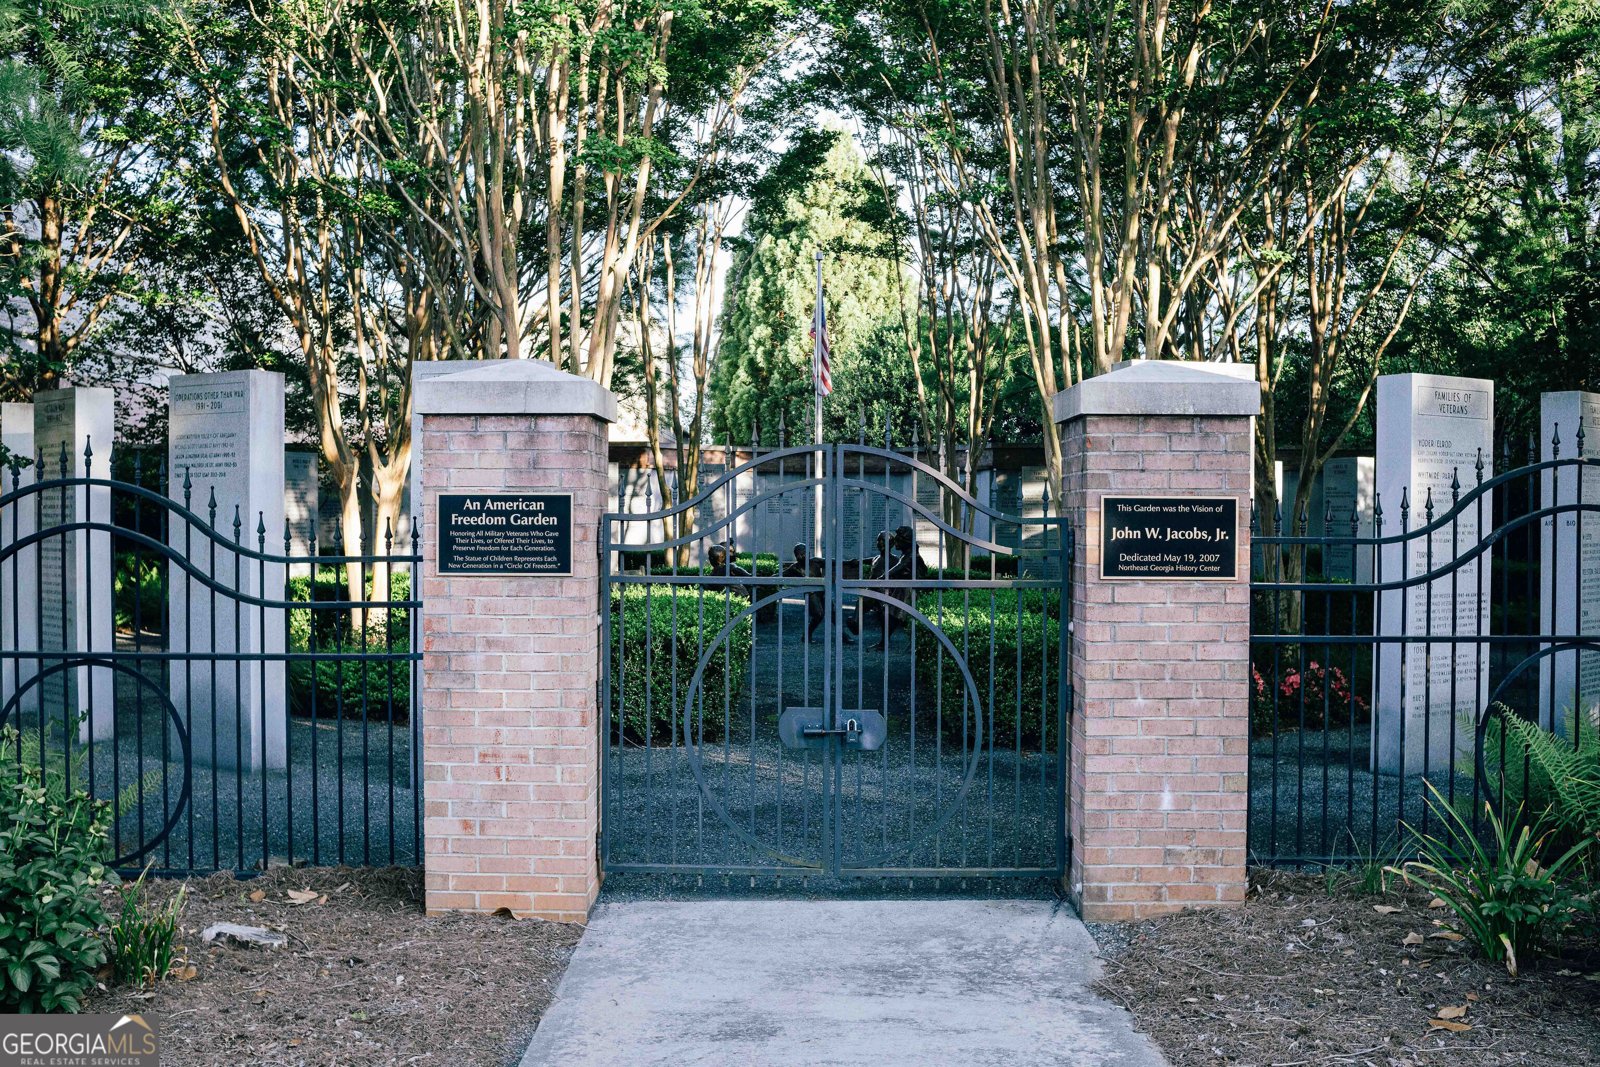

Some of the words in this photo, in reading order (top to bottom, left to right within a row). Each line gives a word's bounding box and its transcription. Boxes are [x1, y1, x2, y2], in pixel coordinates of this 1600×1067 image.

[1434, 391, 1460, 402] FAMILIES
[1464, 393, 1471, 403] OF
[1439, 404, 1468, 415] VETERANS
[464, 498, 480, 510] An
[484, 498, 544, 510] American
[451, 513, 506, 525] Freedom
[510, 513, 558, 525] Garden
[1111, 526, 1141, 541] John
[1145, 527, 1162, 539] W.
[1165, 527, 1212, 541] Jacobs,
[1215, 528, 1229, 541] Jr.
[1120, 553, 1161, 562] Dedicated
[1164, 554, 1181, 564] May
[1184, 554, 1196, 563] 19,
